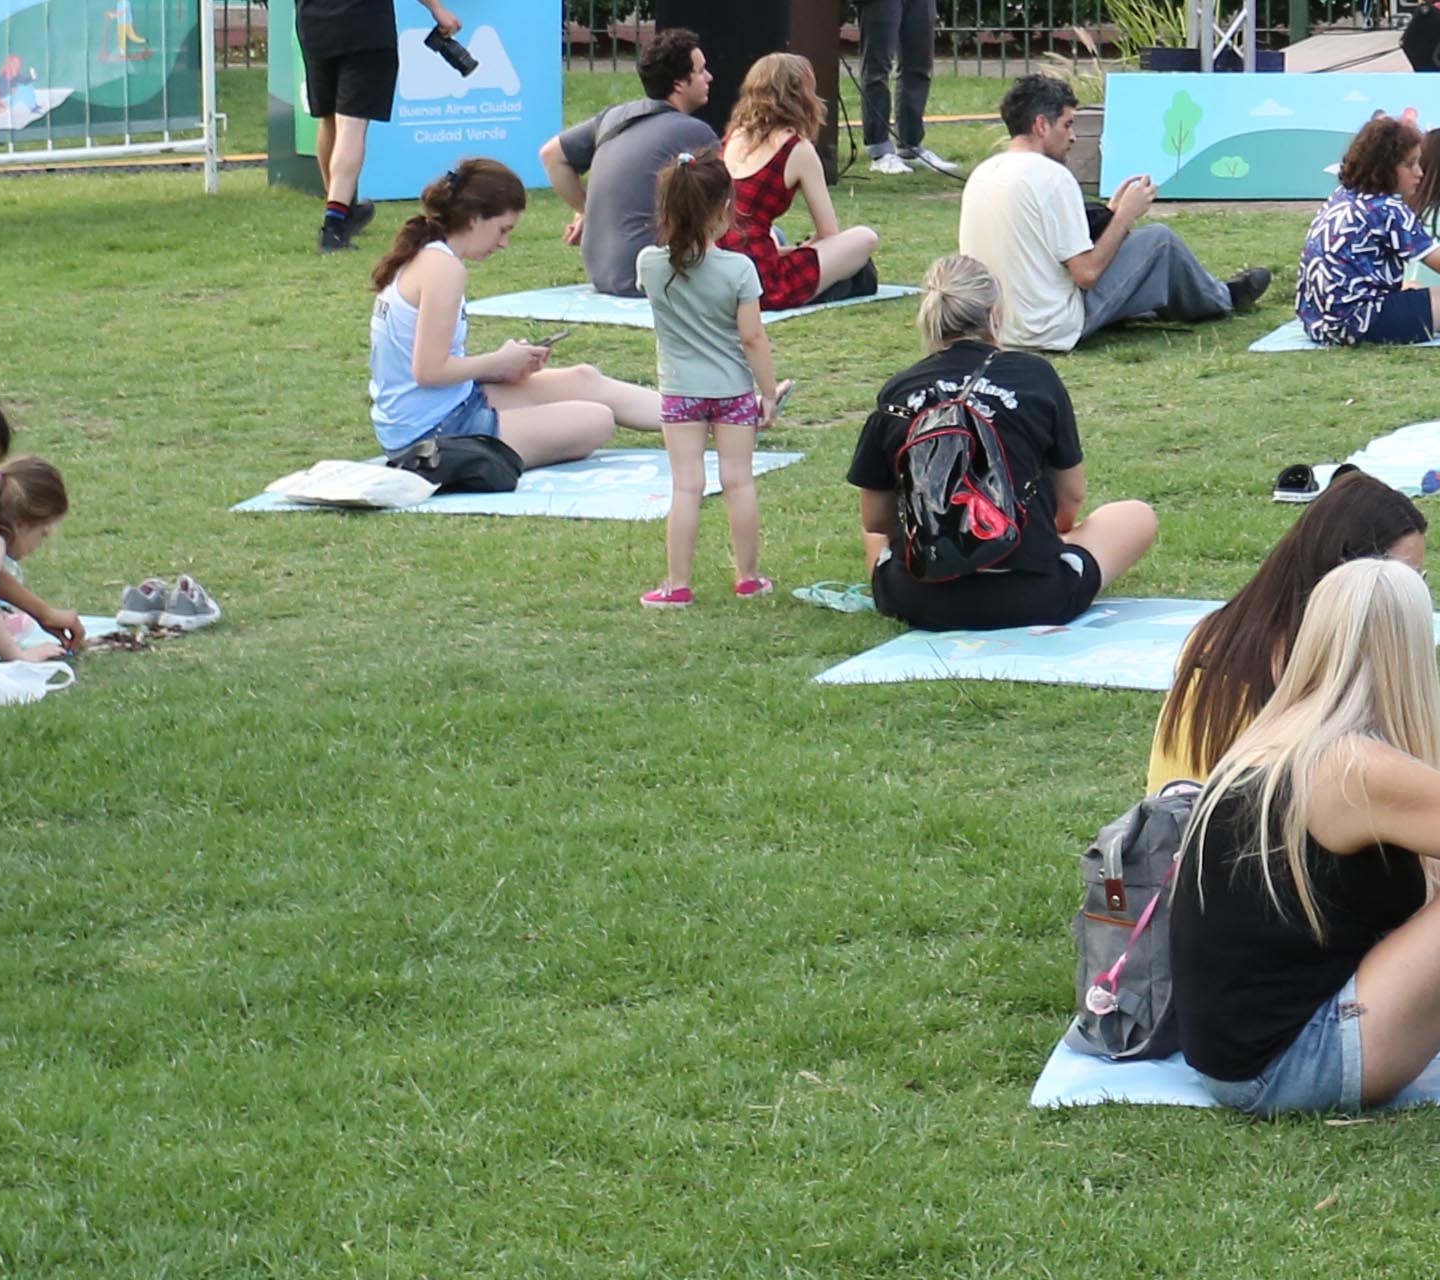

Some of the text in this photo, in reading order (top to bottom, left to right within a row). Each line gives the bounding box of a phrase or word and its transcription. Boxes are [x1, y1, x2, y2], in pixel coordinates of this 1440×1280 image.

[400, 100, 522, 117] Buenos Aires Ciudad
[413, 126, 507, 143] Ciudad Verde
